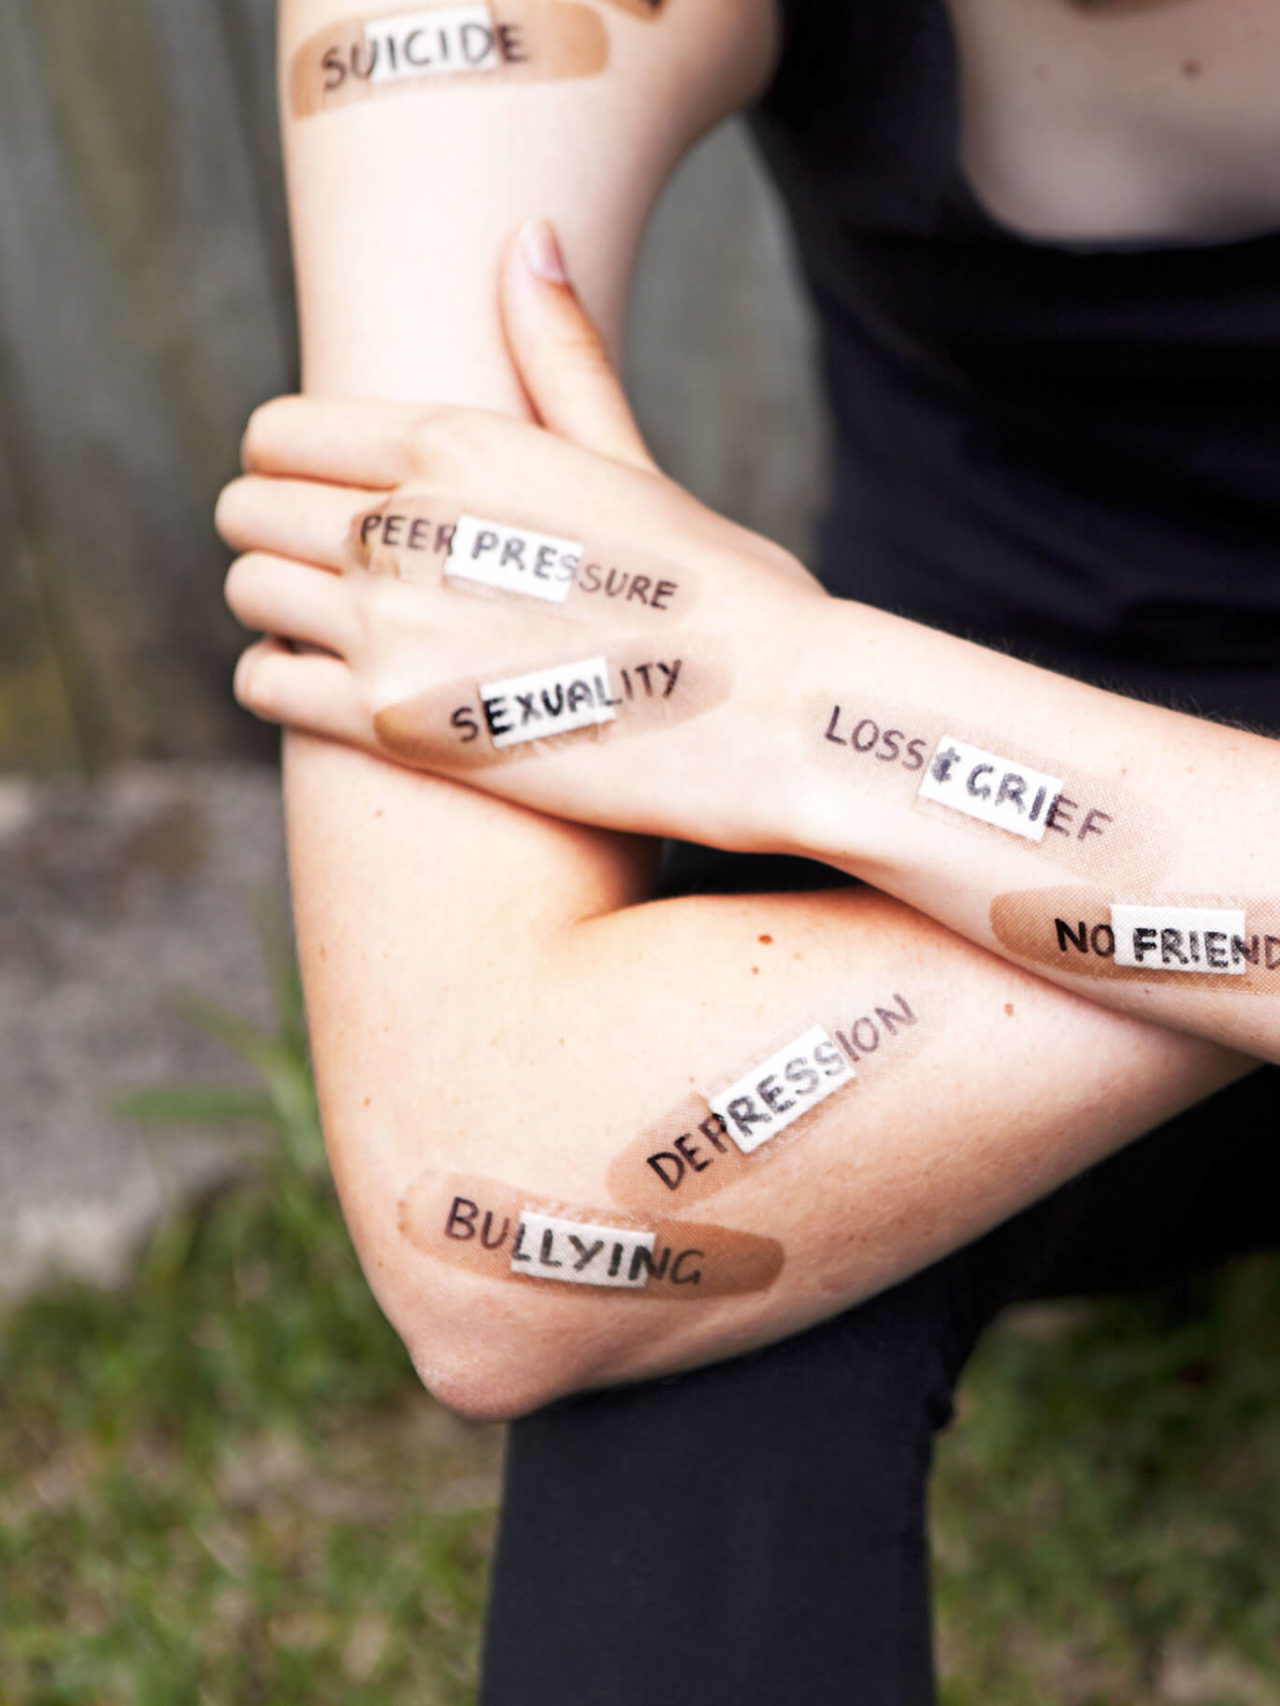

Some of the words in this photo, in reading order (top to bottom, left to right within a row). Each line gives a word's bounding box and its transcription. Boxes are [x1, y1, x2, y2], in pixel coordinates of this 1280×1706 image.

[321, 23, 528, 92] SUICIDE
[360, 514, 458, 558] PEER
[470, 530, 678, 611] PRESSURE
[450, 659, 683, 743] SEXUALITY
[824, 705, 928, 771] LOSS
[966, 762, 1113, 840] GRIEF
[1054, 918, 1116, 959] NO
[645, 993, 919, 1191] DEPRESSION
[443, 1196, 705, 1286] BULLYING
